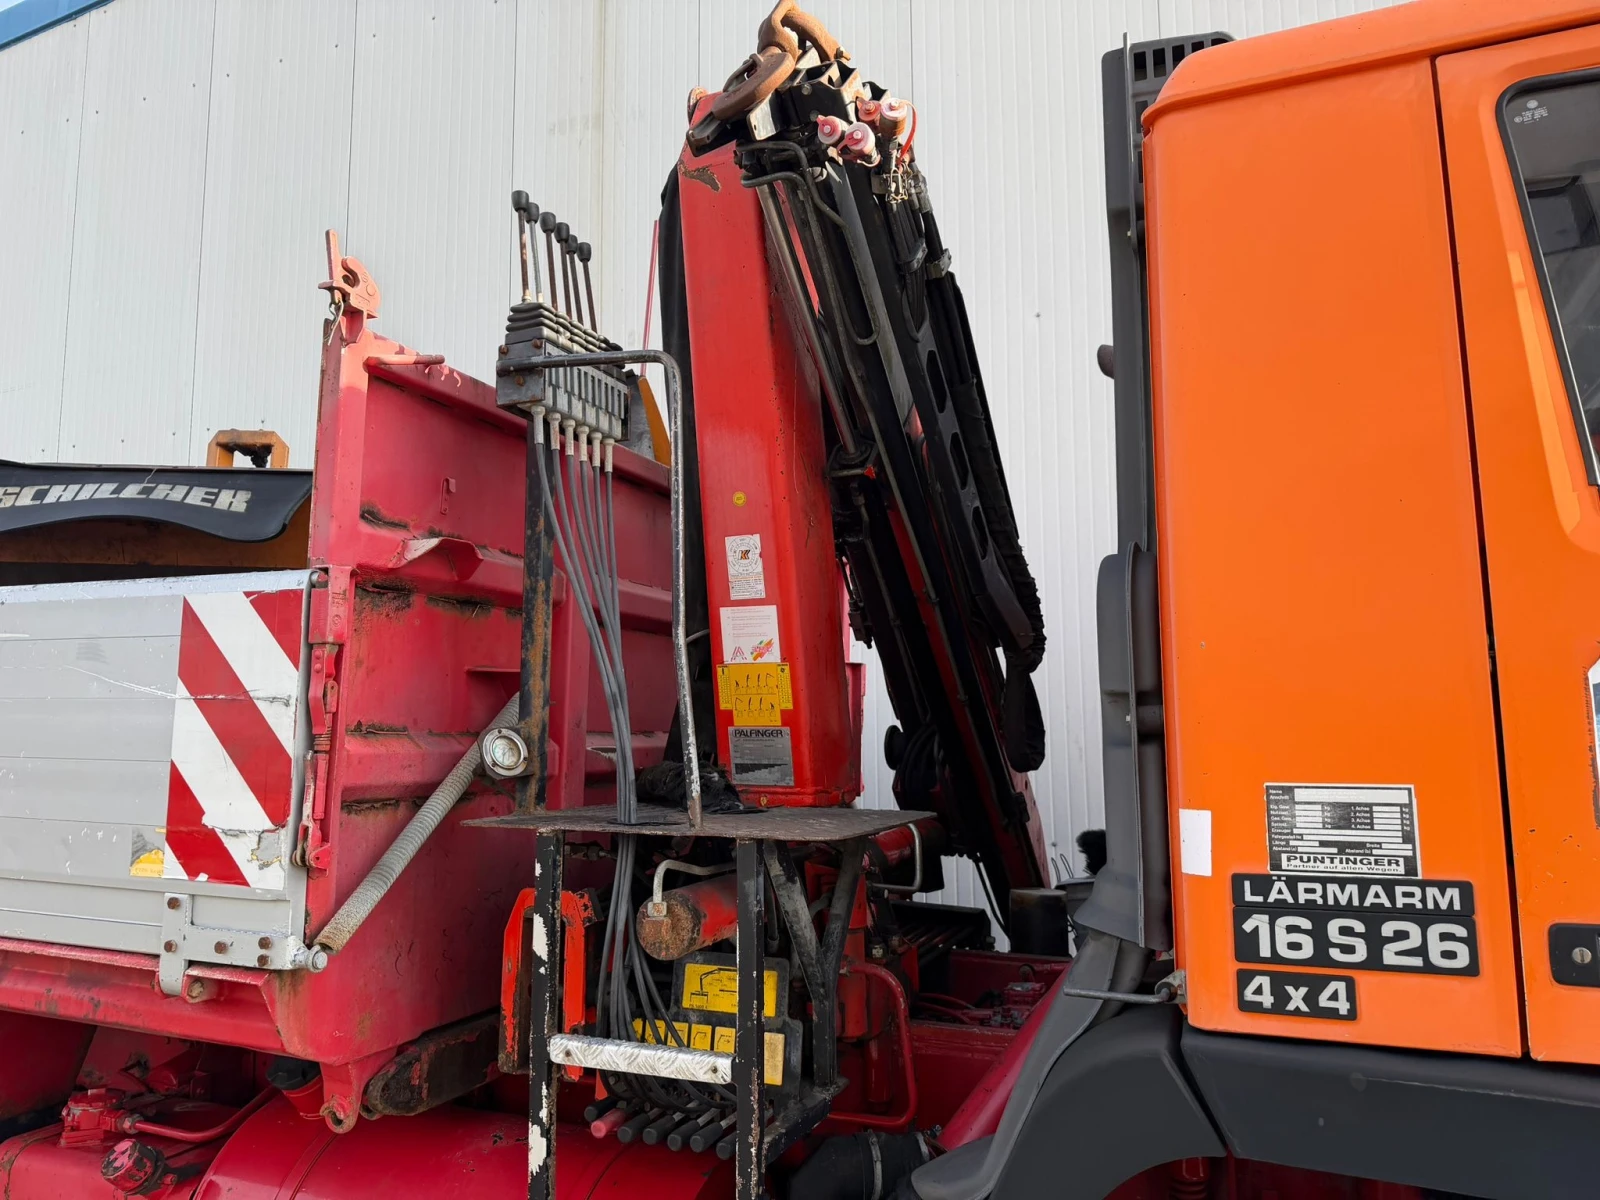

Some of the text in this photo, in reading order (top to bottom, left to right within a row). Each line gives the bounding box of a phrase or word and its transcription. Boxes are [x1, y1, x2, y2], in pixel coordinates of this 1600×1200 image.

[0, 482, 252, 512] SCHILCHER
[1286, 855, 1401, 867] PUNTINGER
[1243, 876, 1461, 910] LÄRMARM
[1241, 914, 1470, 969] 16 S 26
